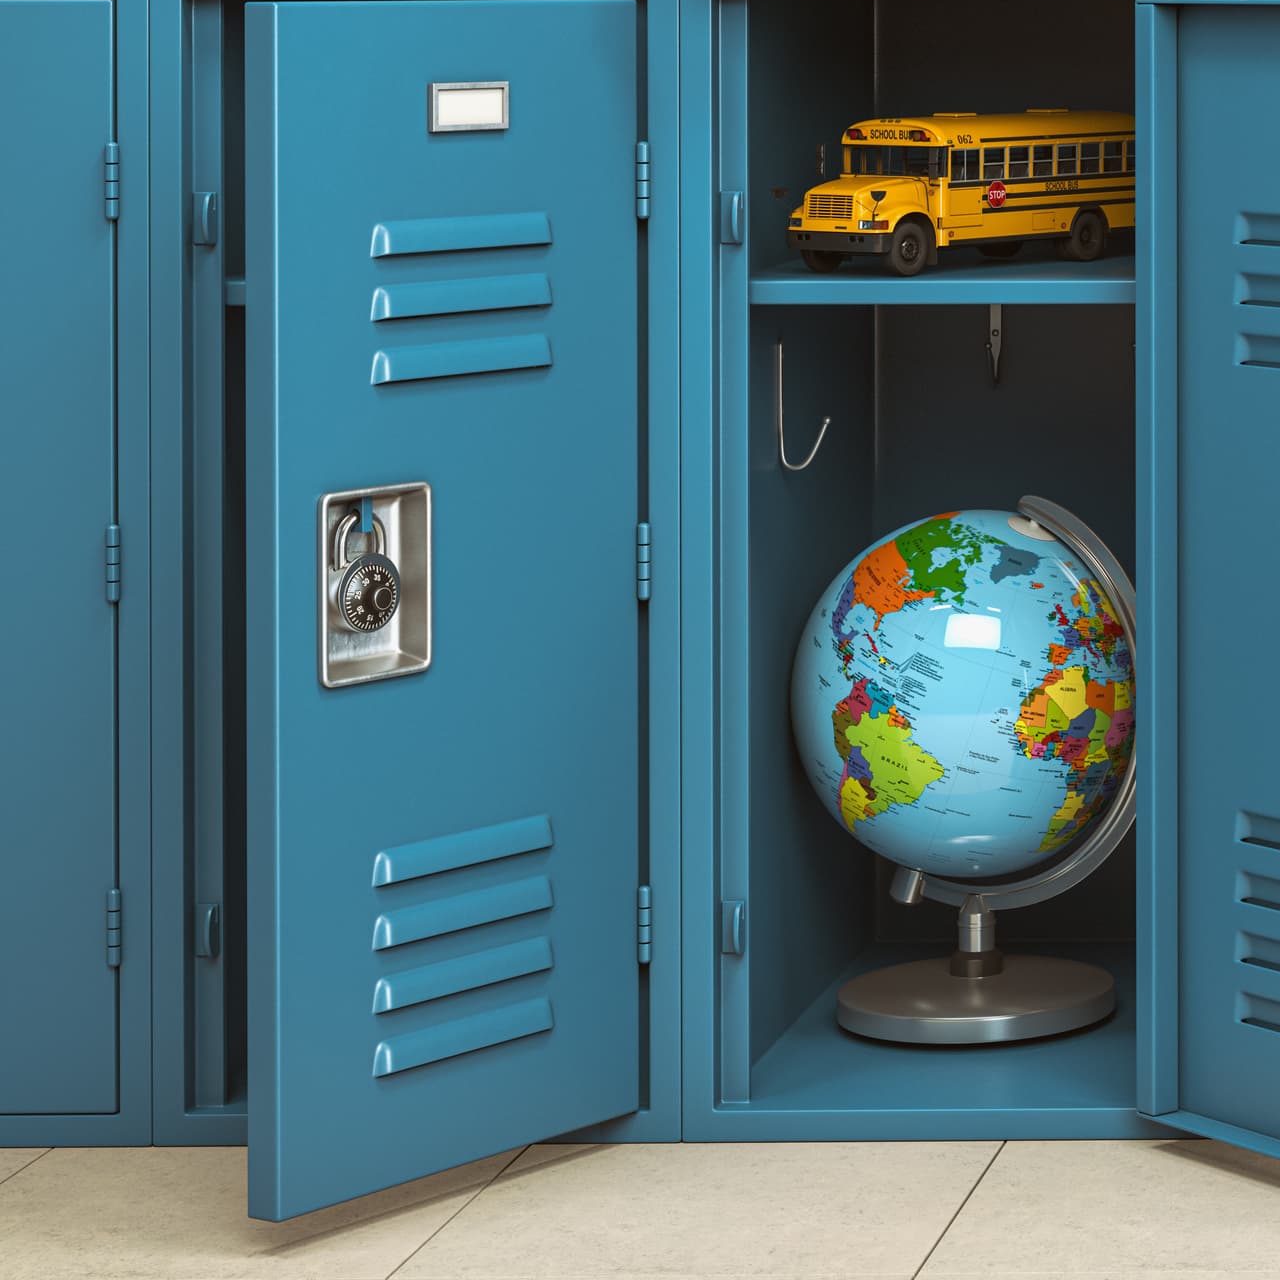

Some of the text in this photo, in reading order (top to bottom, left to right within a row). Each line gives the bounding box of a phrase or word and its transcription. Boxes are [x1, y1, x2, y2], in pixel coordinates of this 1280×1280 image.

[870, 129, 898, 140] SCHOOL
[957, 134, 974, 144] 062
[1045, 180, 1079, 192] SCHOOL BUS
[989, 190, 1006, 200] STOP
[881, 755, 908, 771] BRAZIL
